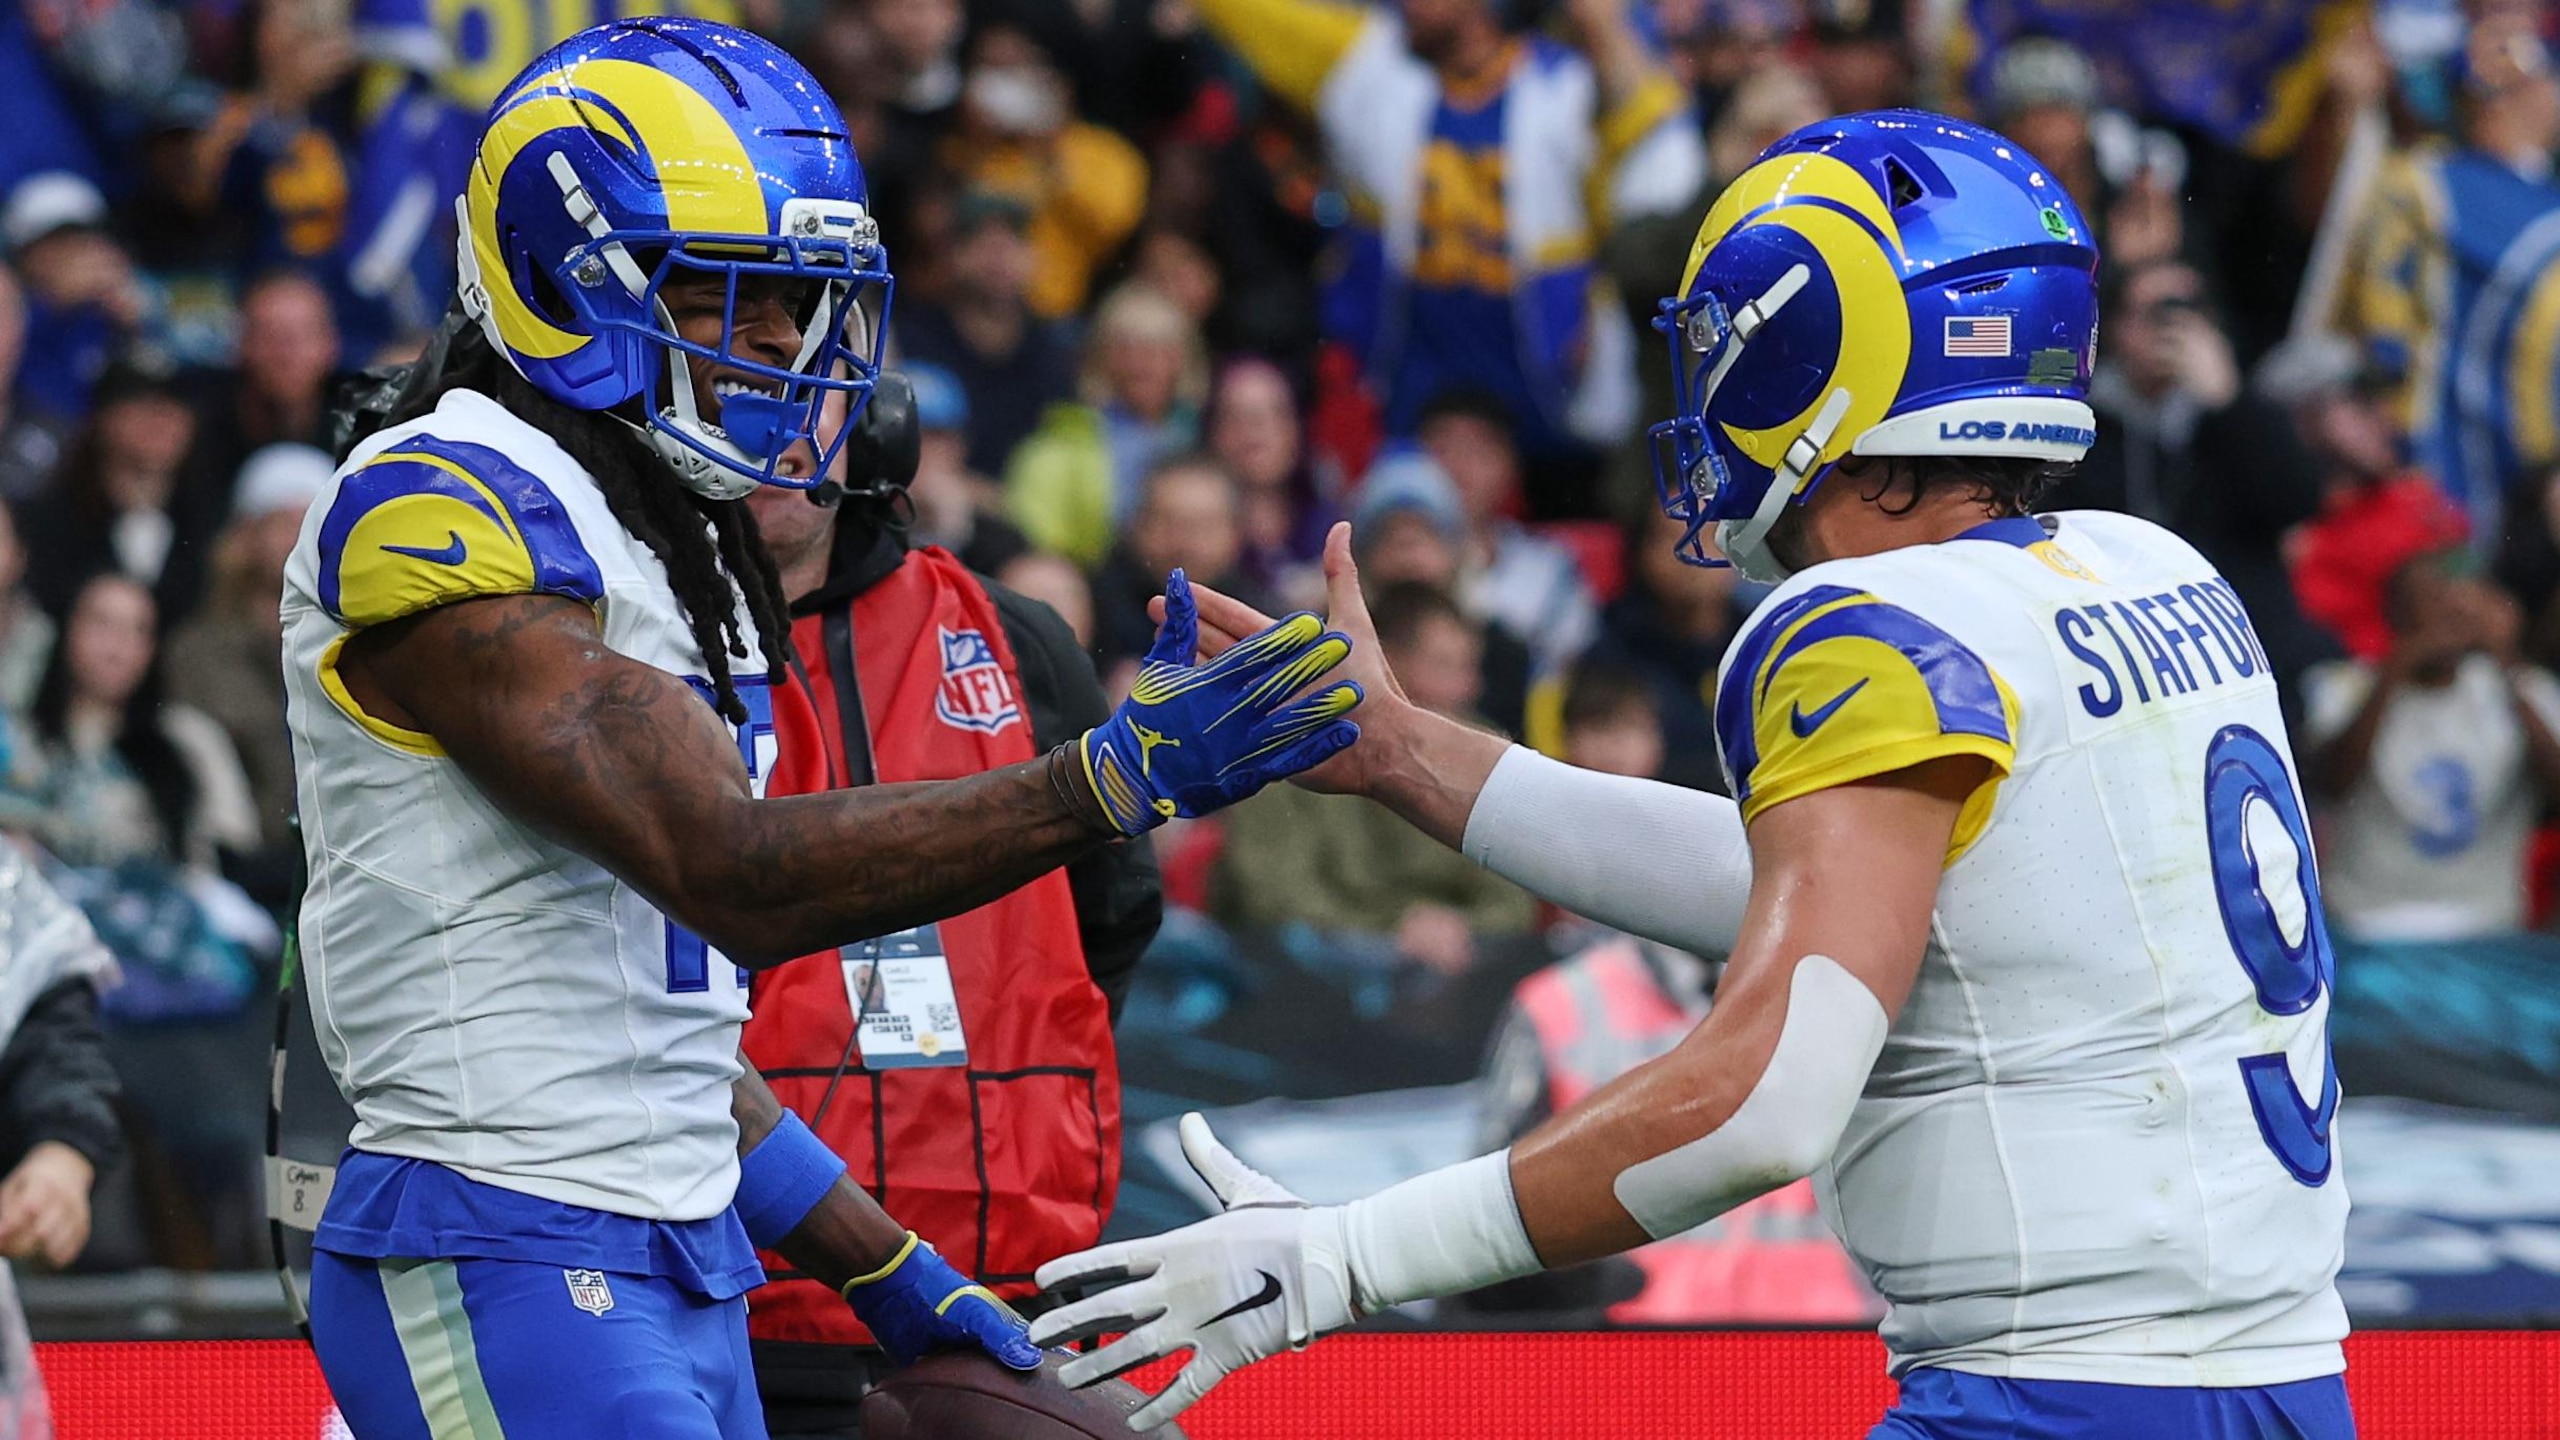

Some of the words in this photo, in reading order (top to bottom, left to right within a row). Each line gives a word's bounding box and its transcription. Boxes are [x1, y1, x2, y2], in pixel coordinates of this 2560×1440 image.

[1940, 421, 2006, 440] LOS
[2055, 577, 2271, 718] STAFFOR
[942, 668, 1011, 716] NFL
[2204, 724, 2336, 1187] 9
[293, 1188, 305, 1212] 8
[576, 1287, 607, 1306] NFL
